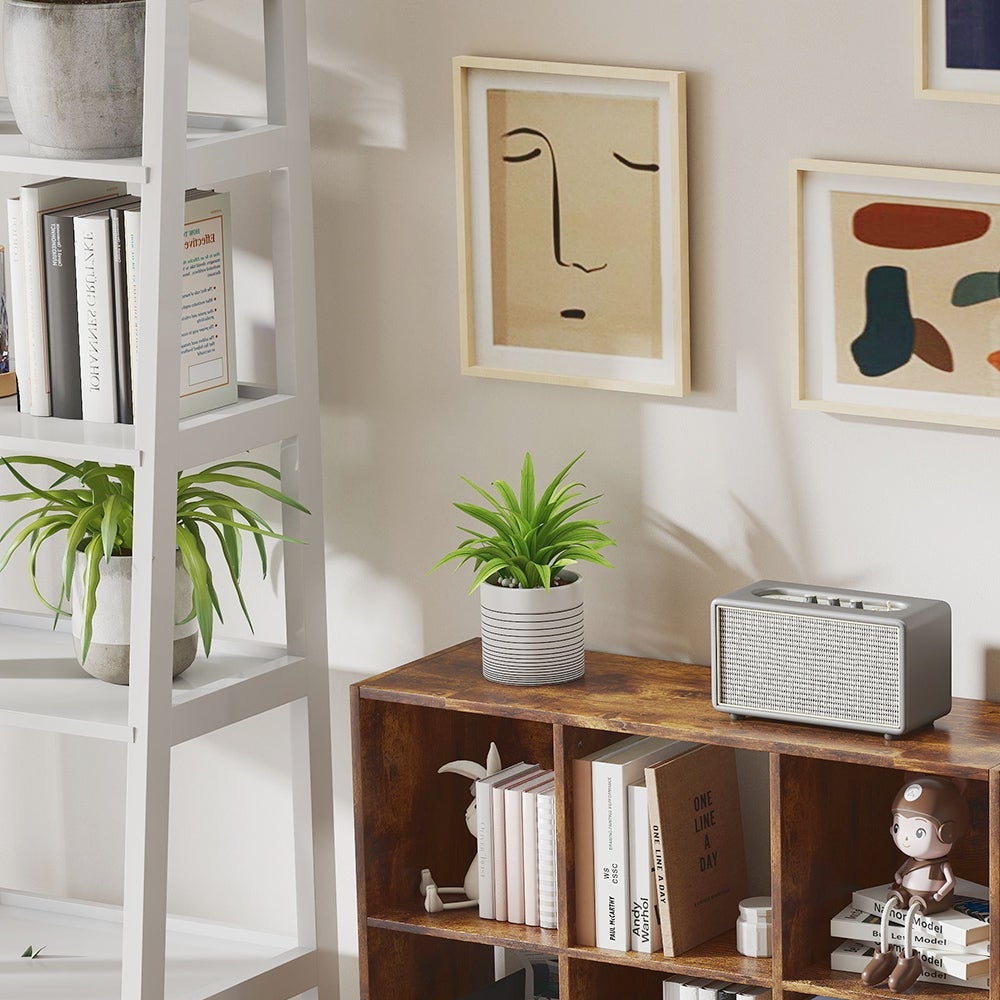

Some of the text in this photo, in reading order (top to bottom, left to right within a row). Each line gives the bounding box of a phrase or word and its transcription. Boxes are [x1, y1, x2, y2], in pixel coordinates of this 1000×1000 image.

[694, 790, 713, 812] ONE
[694, 809, 716, 833] LINE
[652, 825, 660, 843] ONE
[704, 833, 711, 850] A
[655, 849, 663, 871] LINE
[699, 850, 718, 872] DAY
[603, 867, 610, 880] WS
[659, 884, 667, 904] DAY
[632, 901, 643, 936] Andy
[641, 897, 650, 943] Warhol
[912, 916, 943, 934] Model
[914, 936, 947, 946] Model
